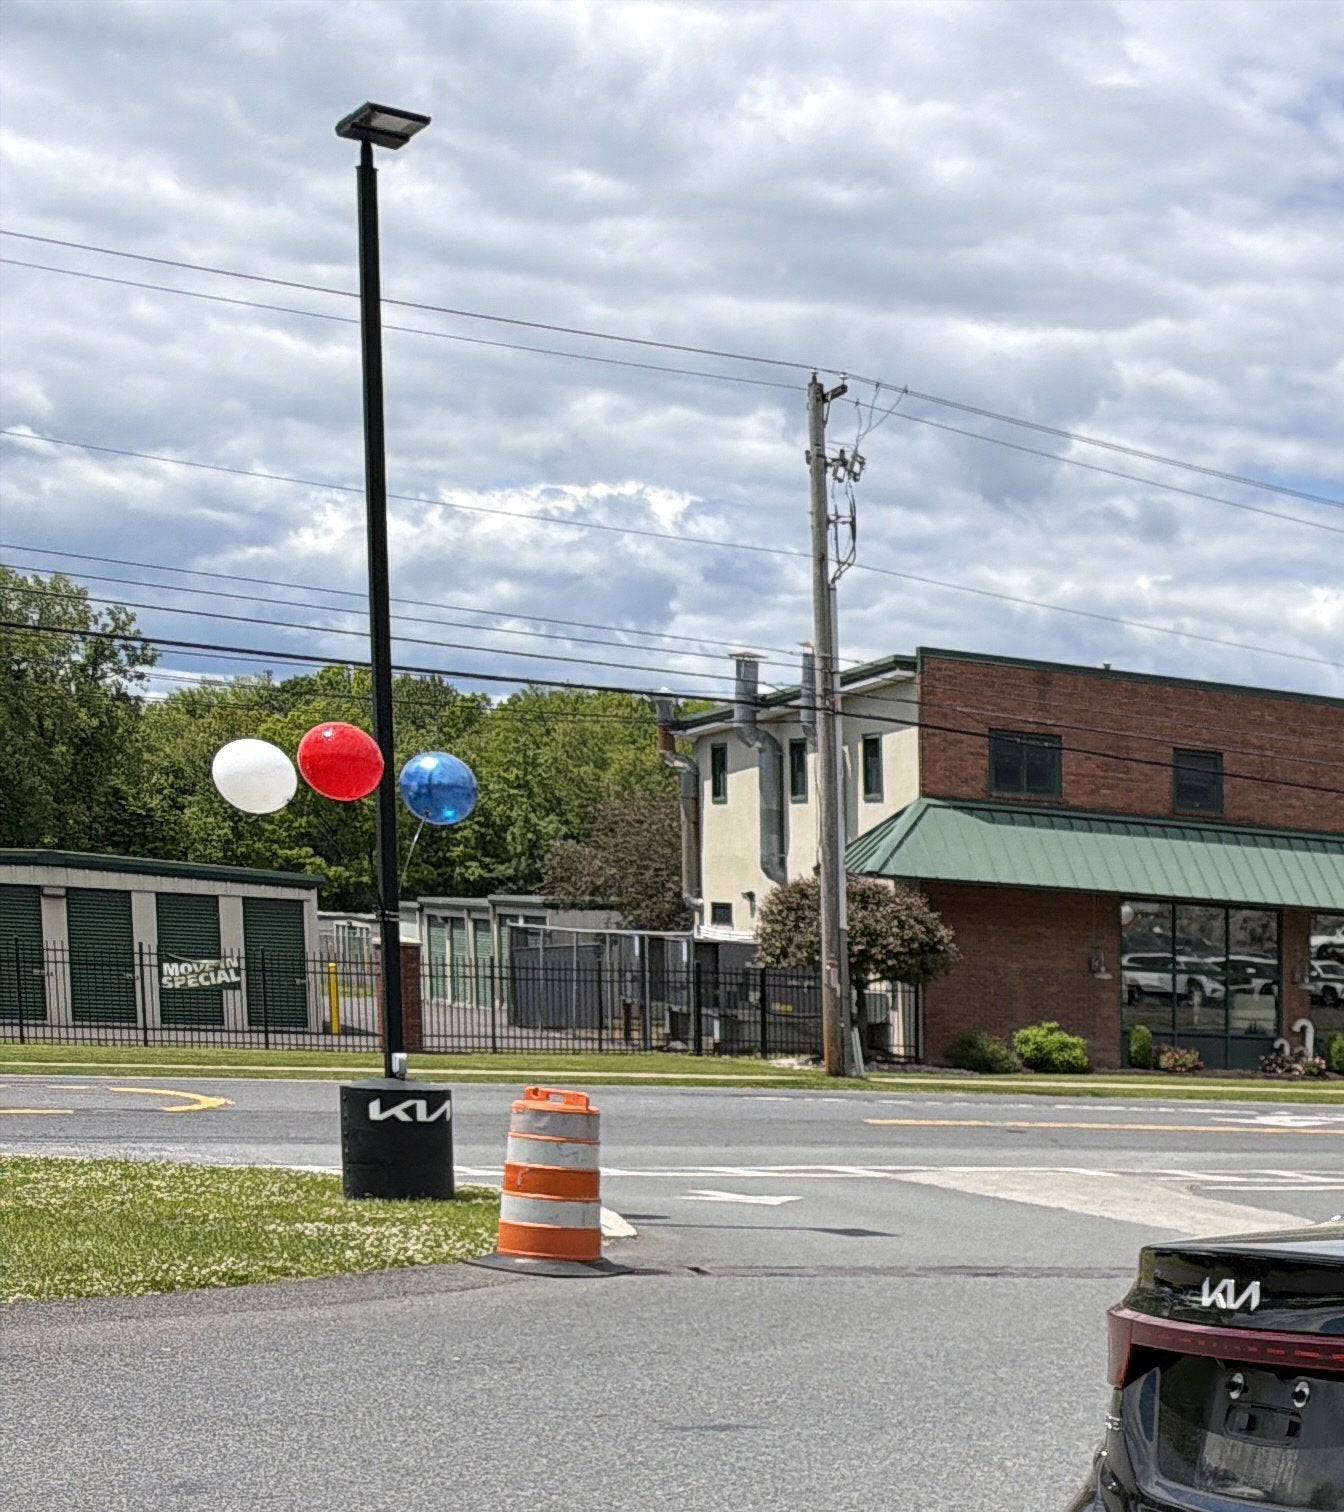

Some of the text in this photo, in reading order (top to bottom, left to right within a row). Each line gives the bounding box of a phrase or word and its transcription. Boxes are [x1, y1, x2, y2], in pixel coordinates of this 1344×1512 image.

[161, 968, 241, 989] SPECIAL
[368, 1097, 451, 1122] KIA
[1201, 1276, 1261, 1312] KIA
